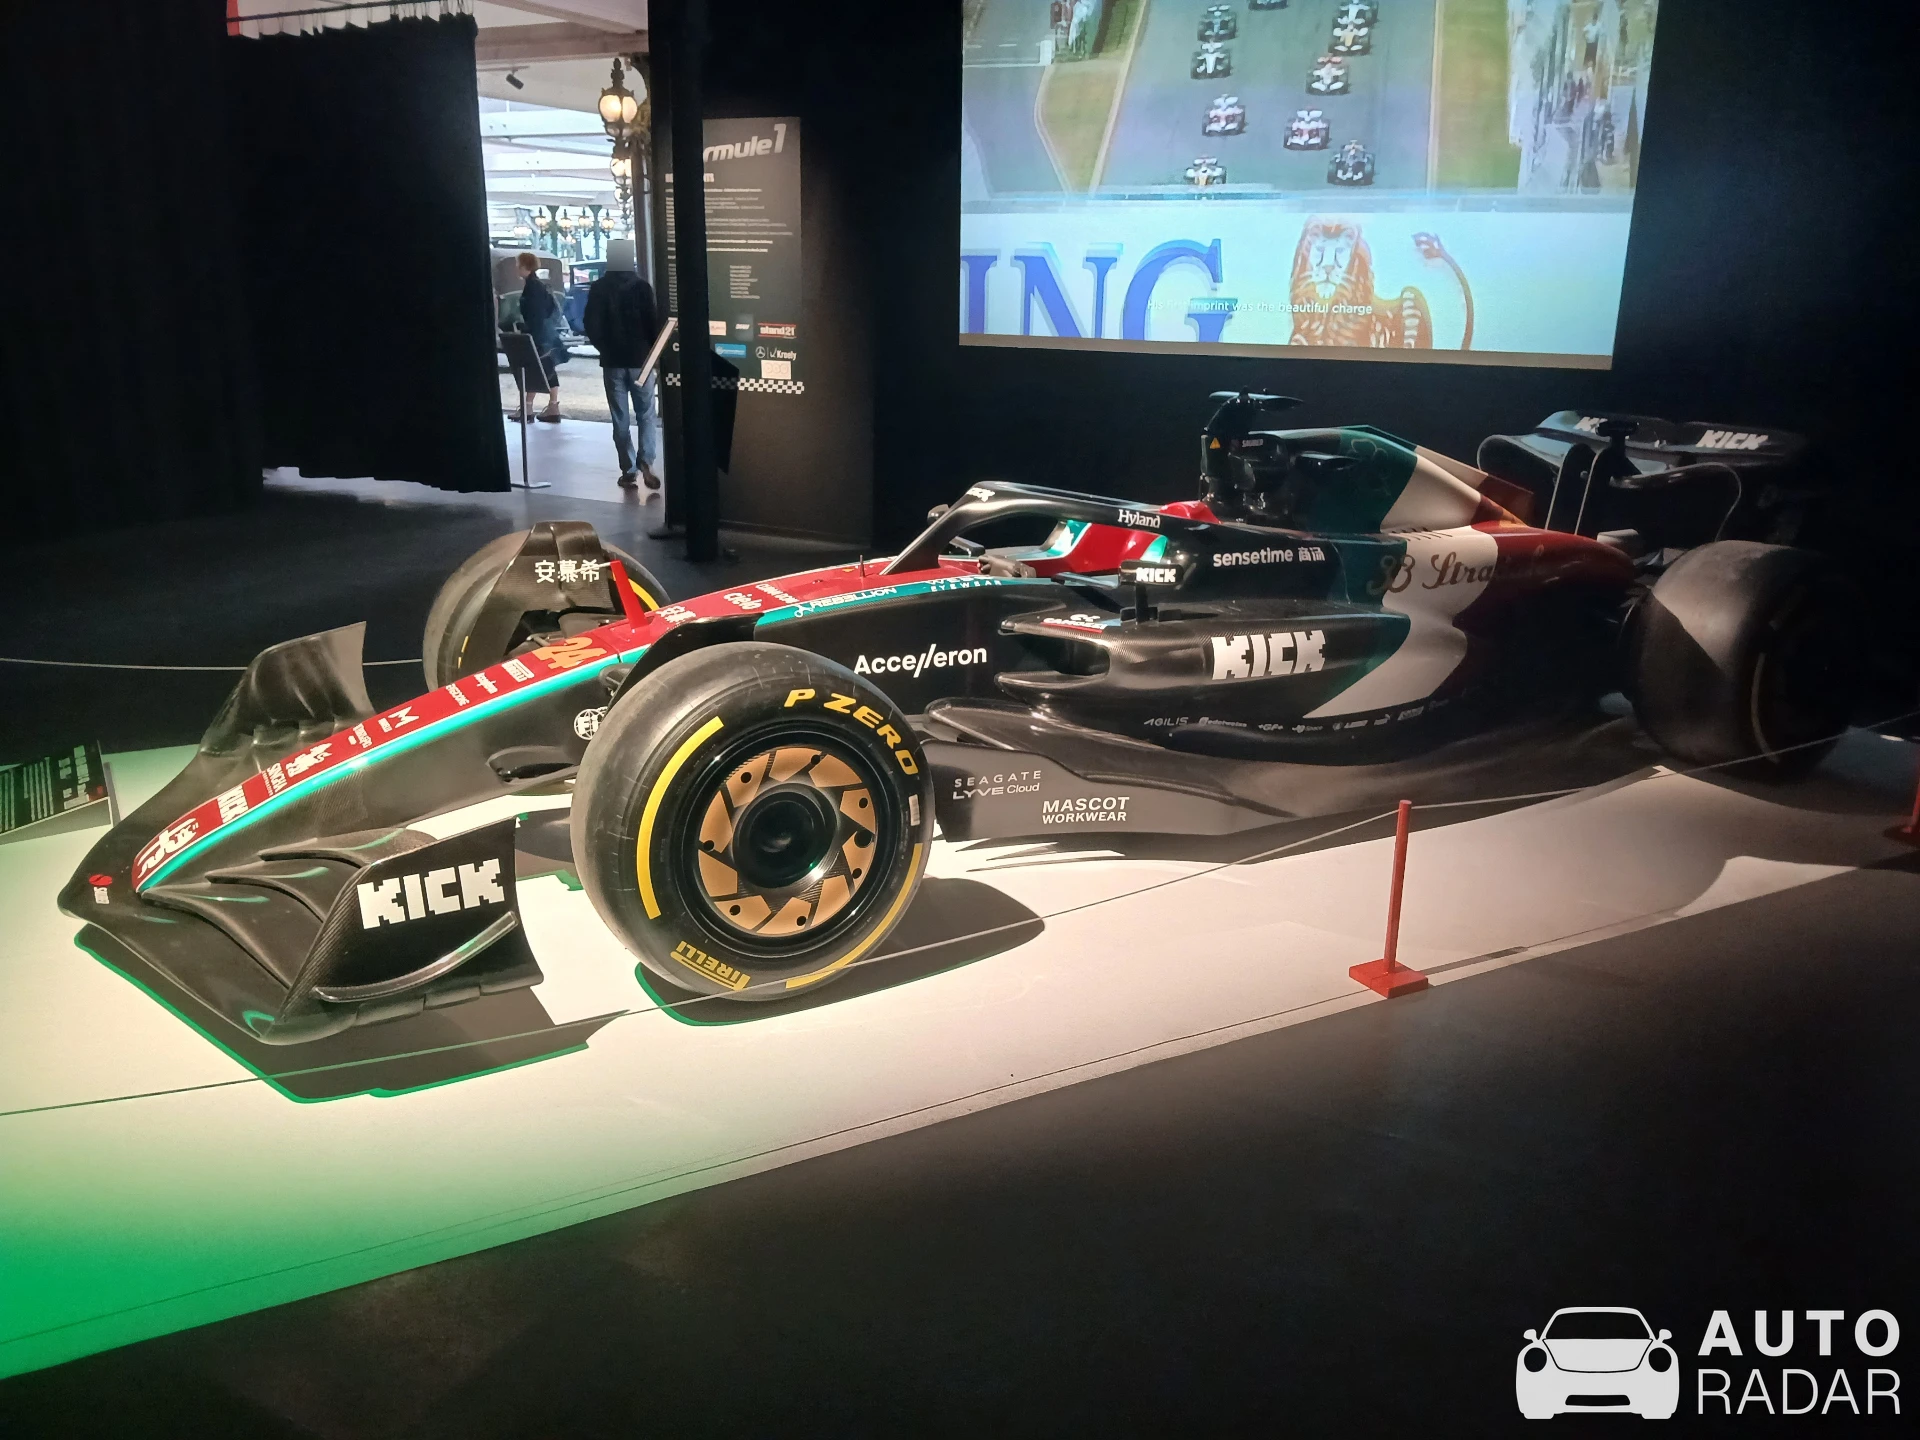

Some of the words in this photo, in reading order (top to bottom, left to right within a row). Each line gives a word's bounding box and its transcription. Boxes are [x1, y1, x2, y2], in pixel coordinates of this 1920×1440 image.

[959, 239, 1238, 342] ING
[1190, 301, 1228, 312] imprint
[1233, 303, 1254, 312] was
[1257, 301, 1274, 312] the
[1279, 301, 1328, 313] beautiful
[1332, 303, 1372, 316] charge
[1696, 429, 1769, 450] KICK
[1118, 509, 1160, 528] Hyland
[1213, 547, 1294, 568] sensetime
[534, 559, 600, 583] 安慕希
[1136, 567, 1176, 583] KICK
[931, 580, 1002, 592] EYEWEAR
[811, 587, 898, 609] REBELLION
[532, 637, 608, 670] 24
[854, 643, 988, 678] Accelleron
[1211, 630, 1326, 680] KICK
[784, 688, 816, 707] P
[824, 692, 918, 775] ZERO
[1144, 716, 1188, 726] AGILIS
[266, 762, 288, 792] SINGHA
[954, 770, 1042, 788] SEAGATE
[952, 786, 1004, 800] LYVE
[1006, 782, 1040, 794] Cloud
[217, 784, 249, 824] KICK
[1042, 796, 1130, 814] MASCOT
[1042, 812, 1127, 825] WORKWEAR
[357, 858, 505, 930] KICK
[670, 940, 751, 991] PIRELLI
